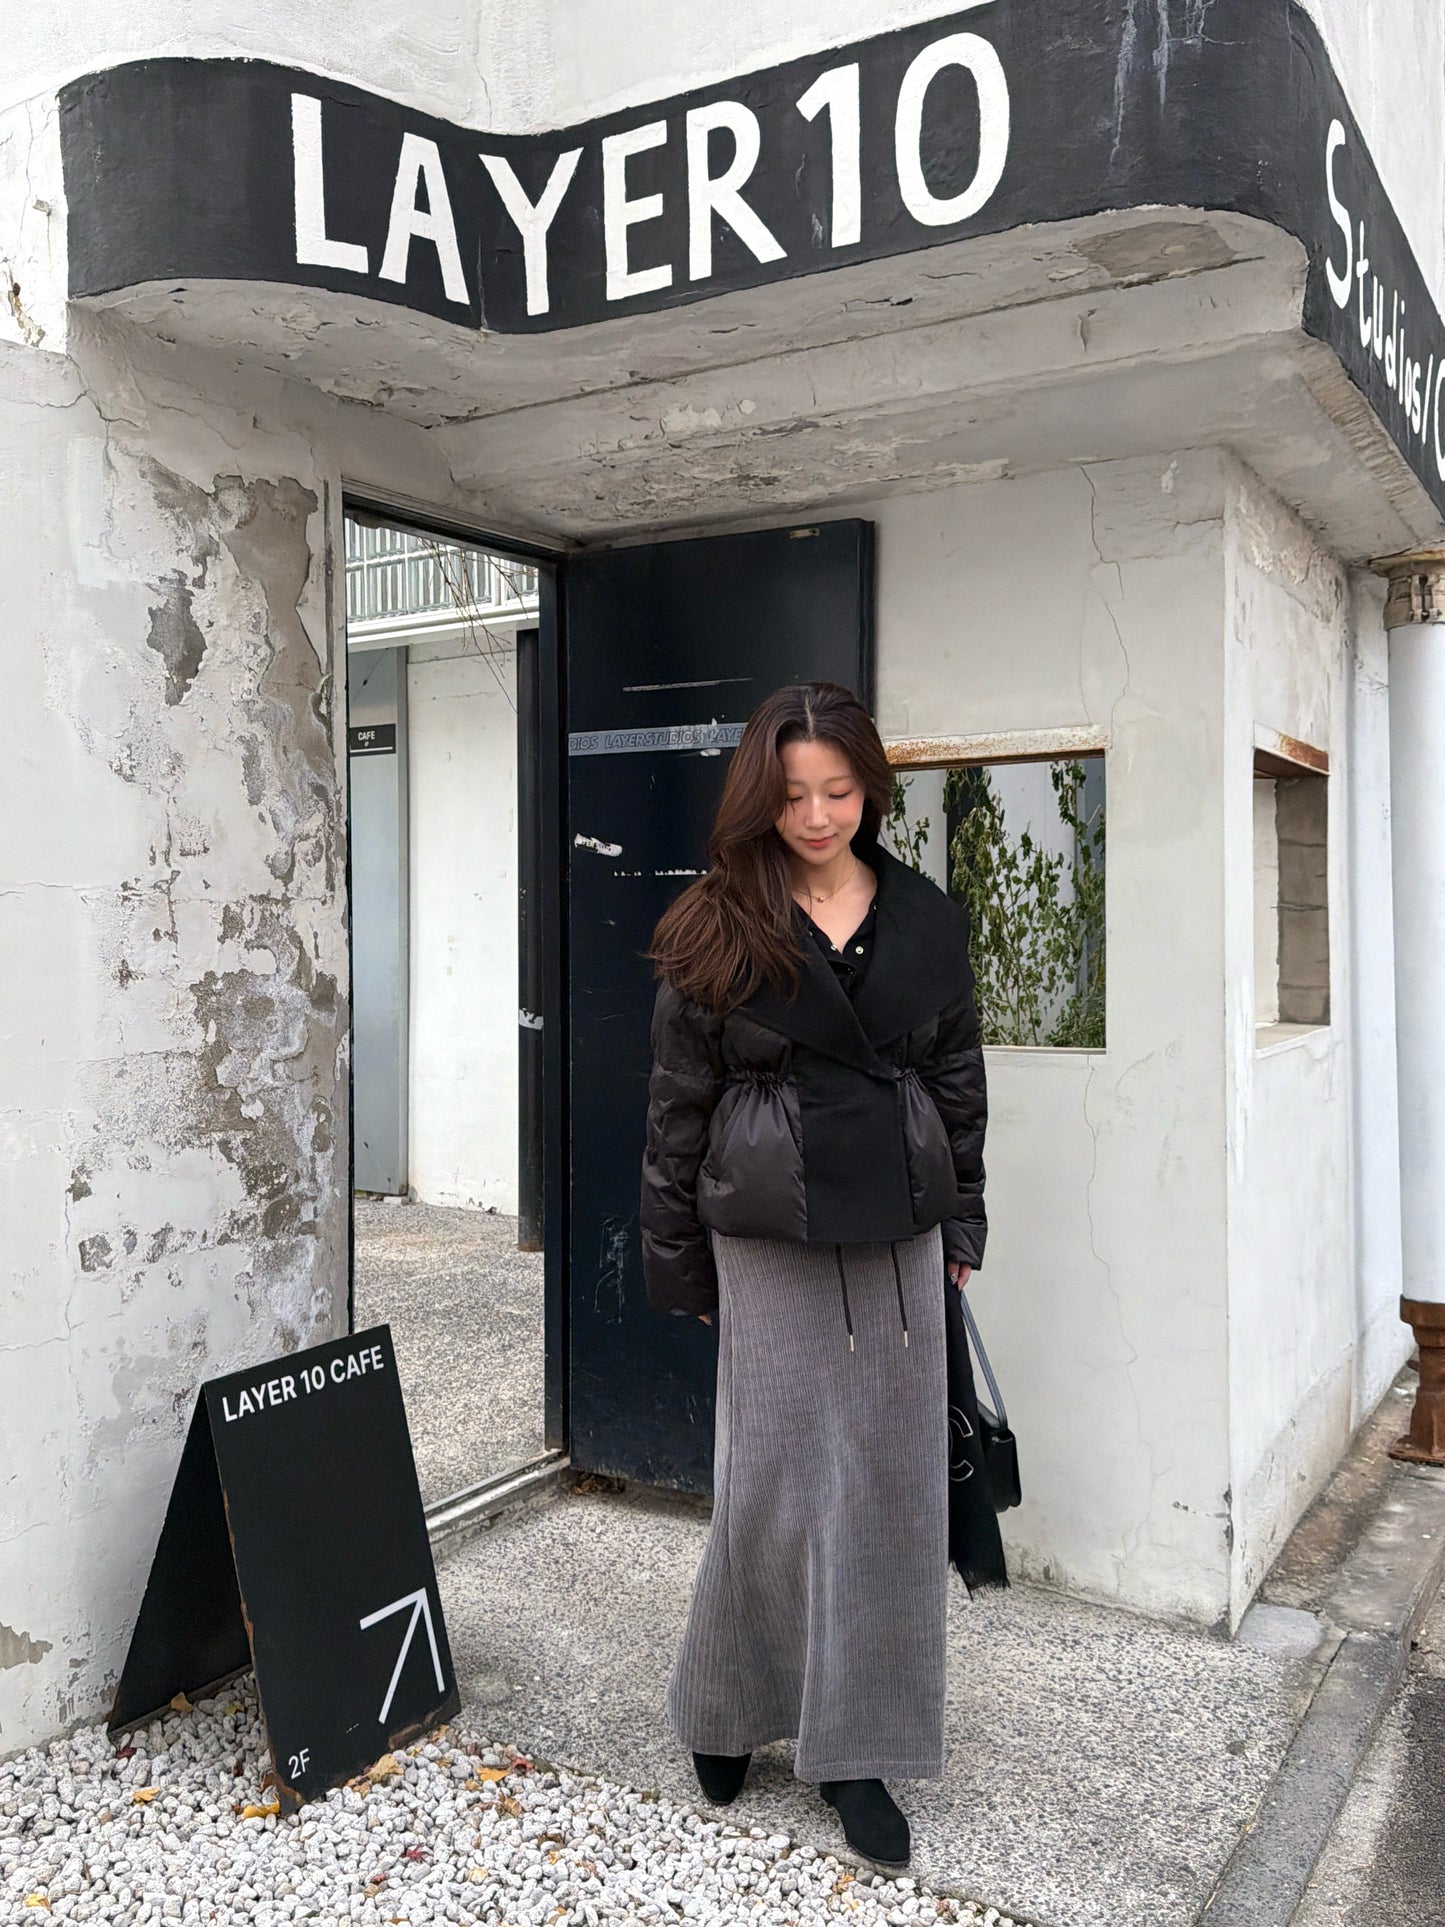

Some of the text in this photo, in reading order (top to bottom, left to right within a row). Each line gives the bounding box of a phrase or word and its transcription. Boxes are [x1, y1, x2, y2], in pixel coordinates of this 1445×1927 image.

[357, 730, 376, 742] CAFE
[604, 729, 703, 750] LAYERSTUDIOS
[708, 727, 746, 743] LAYE
[222, 1344, 385, 1423] LAYER 10 CAFE
[288, 1747, 310, 1780] 2F
